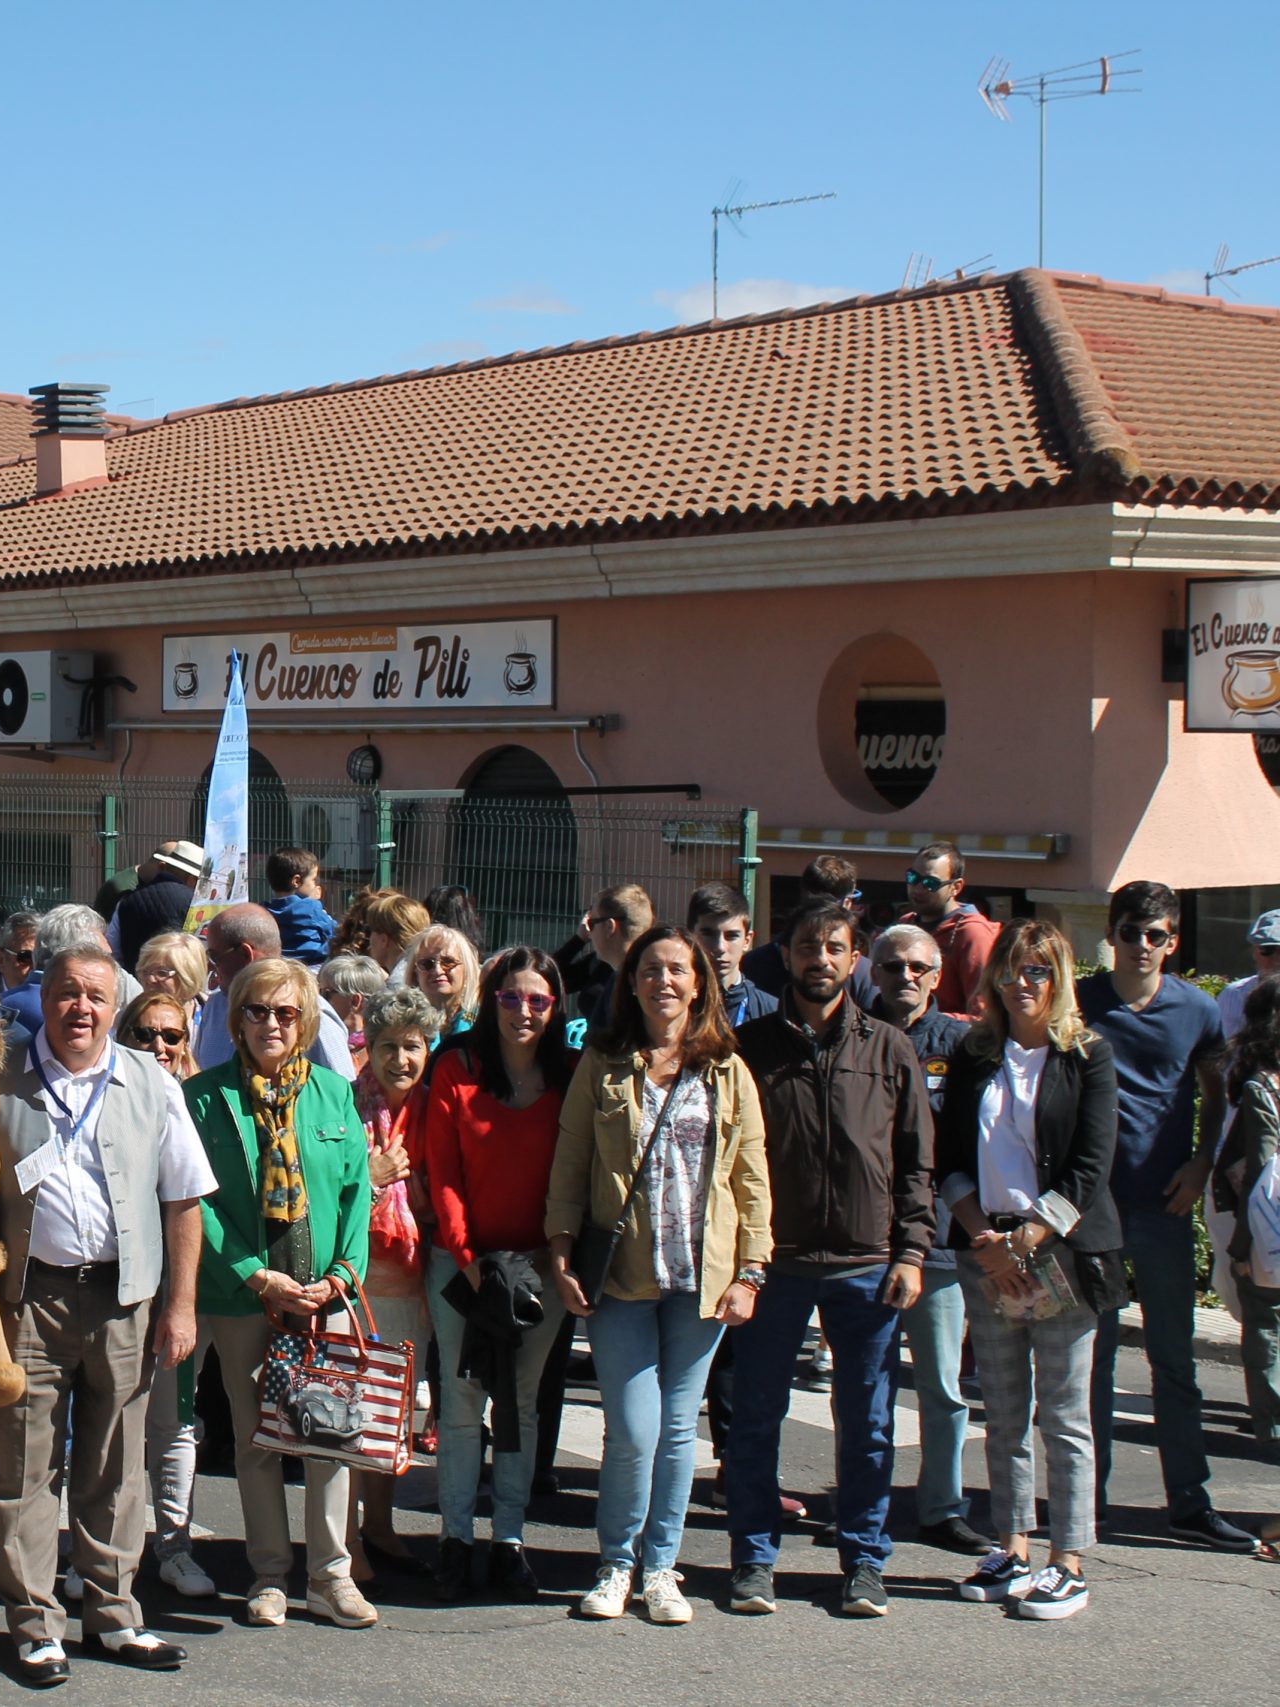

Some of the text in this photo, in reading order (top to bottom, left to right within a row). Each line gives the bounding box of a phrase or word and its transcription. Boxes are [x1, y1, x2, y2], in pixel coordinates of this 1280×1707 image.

[291, 633, 321, 653] Comida
[1191, 622, 1209, 657] El
[1210, 612, 1270, 649] Cuenco
[254, 642, 362, 701] Cuenco
[373, 658, 403, 698] de
[414, 635, 471, 698] Pili
